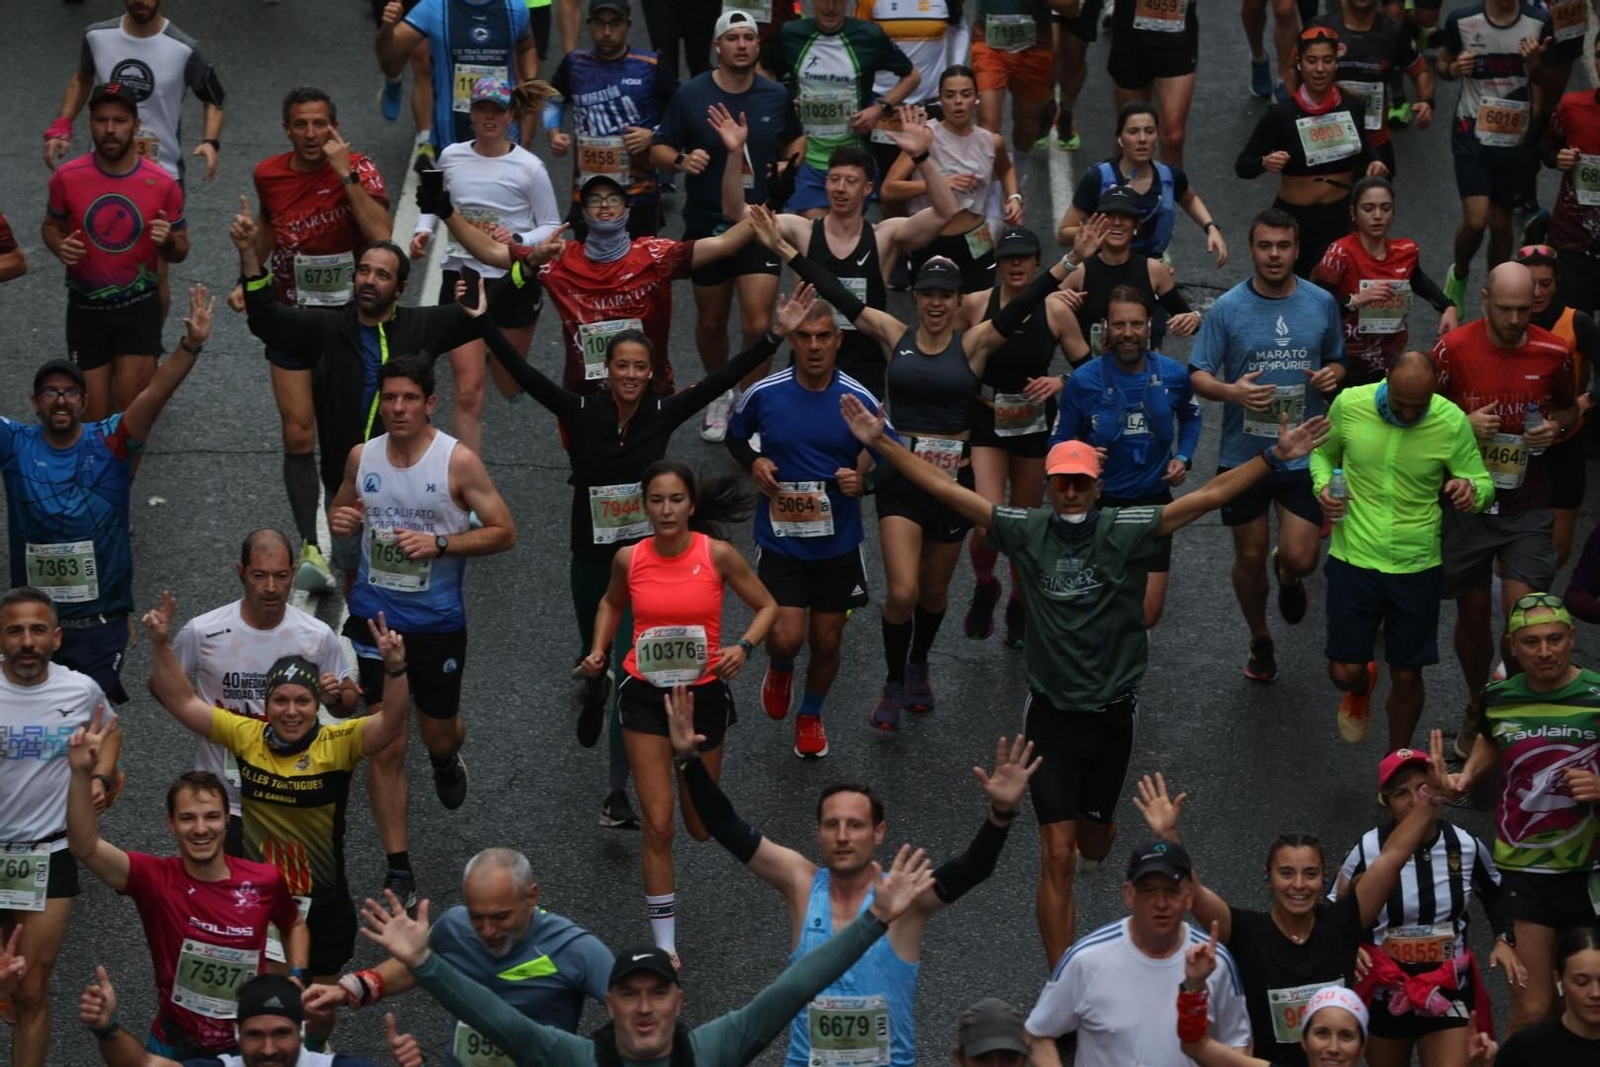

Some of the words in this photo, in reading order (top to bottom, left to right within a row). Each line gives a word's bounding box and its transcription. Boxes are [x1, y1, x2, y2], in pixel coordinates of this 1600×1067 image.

[829, 74, 850, 83] Park
[804, 102, 845, 119] 10281
[1486, 110, 1520, 127] 6018
[584, 150, 615, 165] 5158
[304, 267, 342, 284] 6737
[1256, 346, 1308, 360] MARATÓ
[601, 498, 641, 518] 7944
[778, 497, 815, 513] 5064
[386, 507, 436, 521] CALIFATO
[376, 543, 414, 565] 765
[36, 559, 79, 577] 7363
[641, 640, 696, 662] 10376
[222, 672, 240, 688] 40
[241, 678, 266, 689] MEDIA
[223, 689, 253, 700] CIUDAD
[255, 689, 266, 700] DE
[252, 773, 270, 786] LES
[189, 960, 241, 988] 7537
[819, 1014, 869, 1037] 6679
